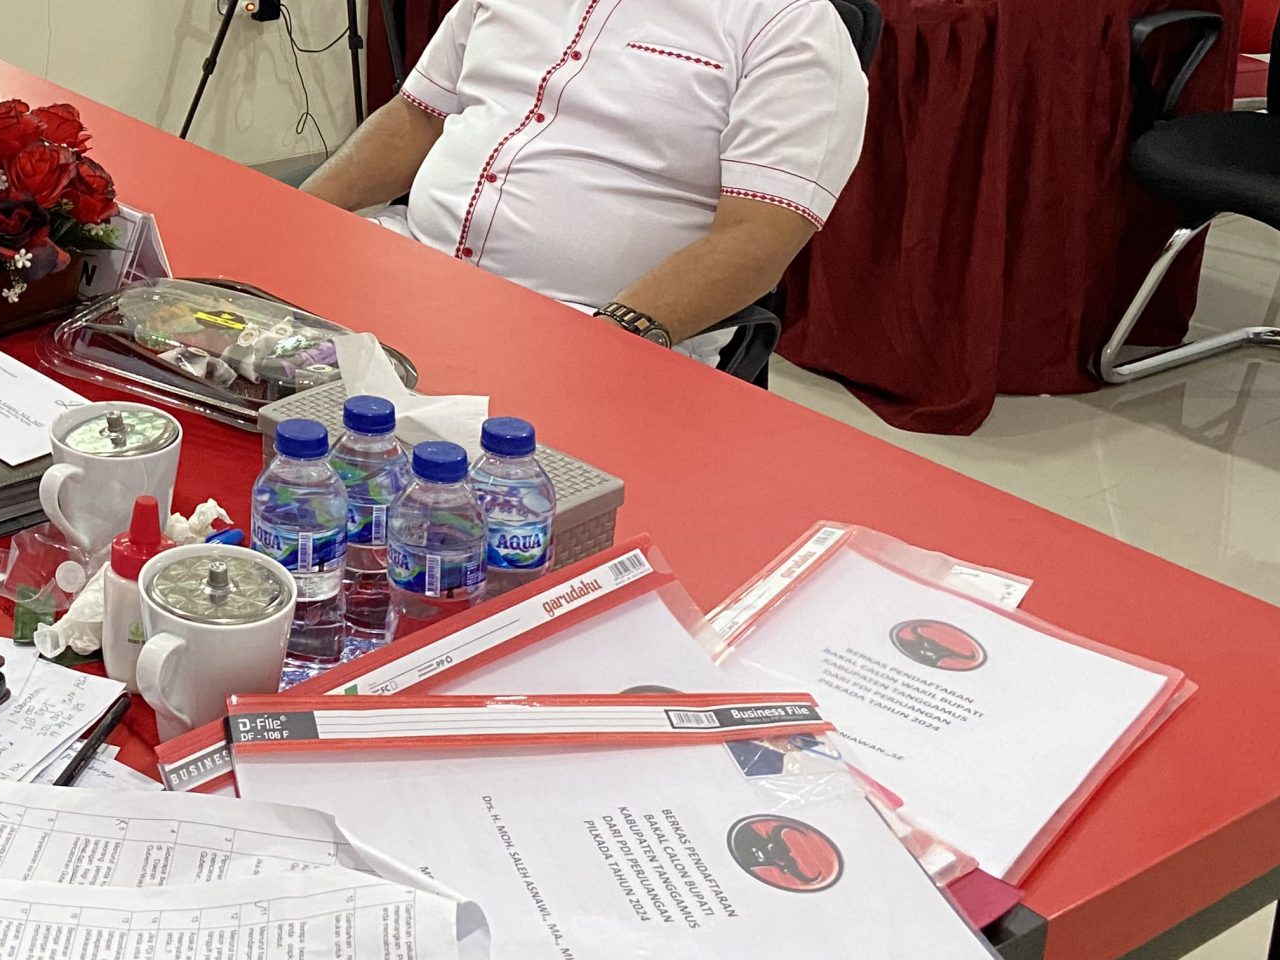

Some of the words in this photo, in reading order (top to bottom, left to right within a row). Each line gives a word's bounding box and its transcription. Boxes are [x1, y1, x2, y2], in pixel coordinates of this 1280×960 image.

[496, 534, 542, 552] AQUA
[542, 577, 602, 617] garudaku
[818, 678, 865, 701] PILKADA
[869, 699, 910, 719] TAHUN
[911, 717, 940, 732] 2024
[823, 648, 857, 666] BAKAL
[860, 665, 898, 684] CALON
[901, 681, 937, 700] WAKIL
[939, 697, 984, 718] BUPATI
[823, 659, 889, 690] KABUPATEN
[892, 687, 968, 722] TANGGAMUS
[823, 669, 850, 684] DARI
[852, 681, 872, 693] PDI
[873, 690, 951, 725] PERJUANGAN
[846, 648, 888, 668] BERKAS
[889, 667, 974, 704] PENDAFTARAN
[241, 732, 255, 742] DF
[264, 731, 281, 740] 106
[283, 730, 289, 739] F
[731, 708, 785, 720] Business
[787, 706, 810, 716] File
[482, 795, 495, 812] Drs.
[490, 814, 502, 824] H.
[496, 825, 514, 850] MOH.
[509, 851, 531, 879] SALEH
[618, 806, 659, 864] KABUPATEN
[653, 863, 701, 929] TANGGAMUS
[643, 814, 669, 845] BAKAL
[663, 846, 690, 879] CALON
[684, 880, 715, 916] BUPATI
[661, 808, 691, 845] BERKAS
[685, 846, 738, 918] PENDAFTARAN
[583, 819, 613, 861] PILKADA
[608, 861, 636, 896] TAHUN
[628, 897, 651, 922] 2024
[602, 815, 622, 838] DARI
[616, 839, 634, 856] PDI
[627, 857, 675, 923] PERJUANGAN
